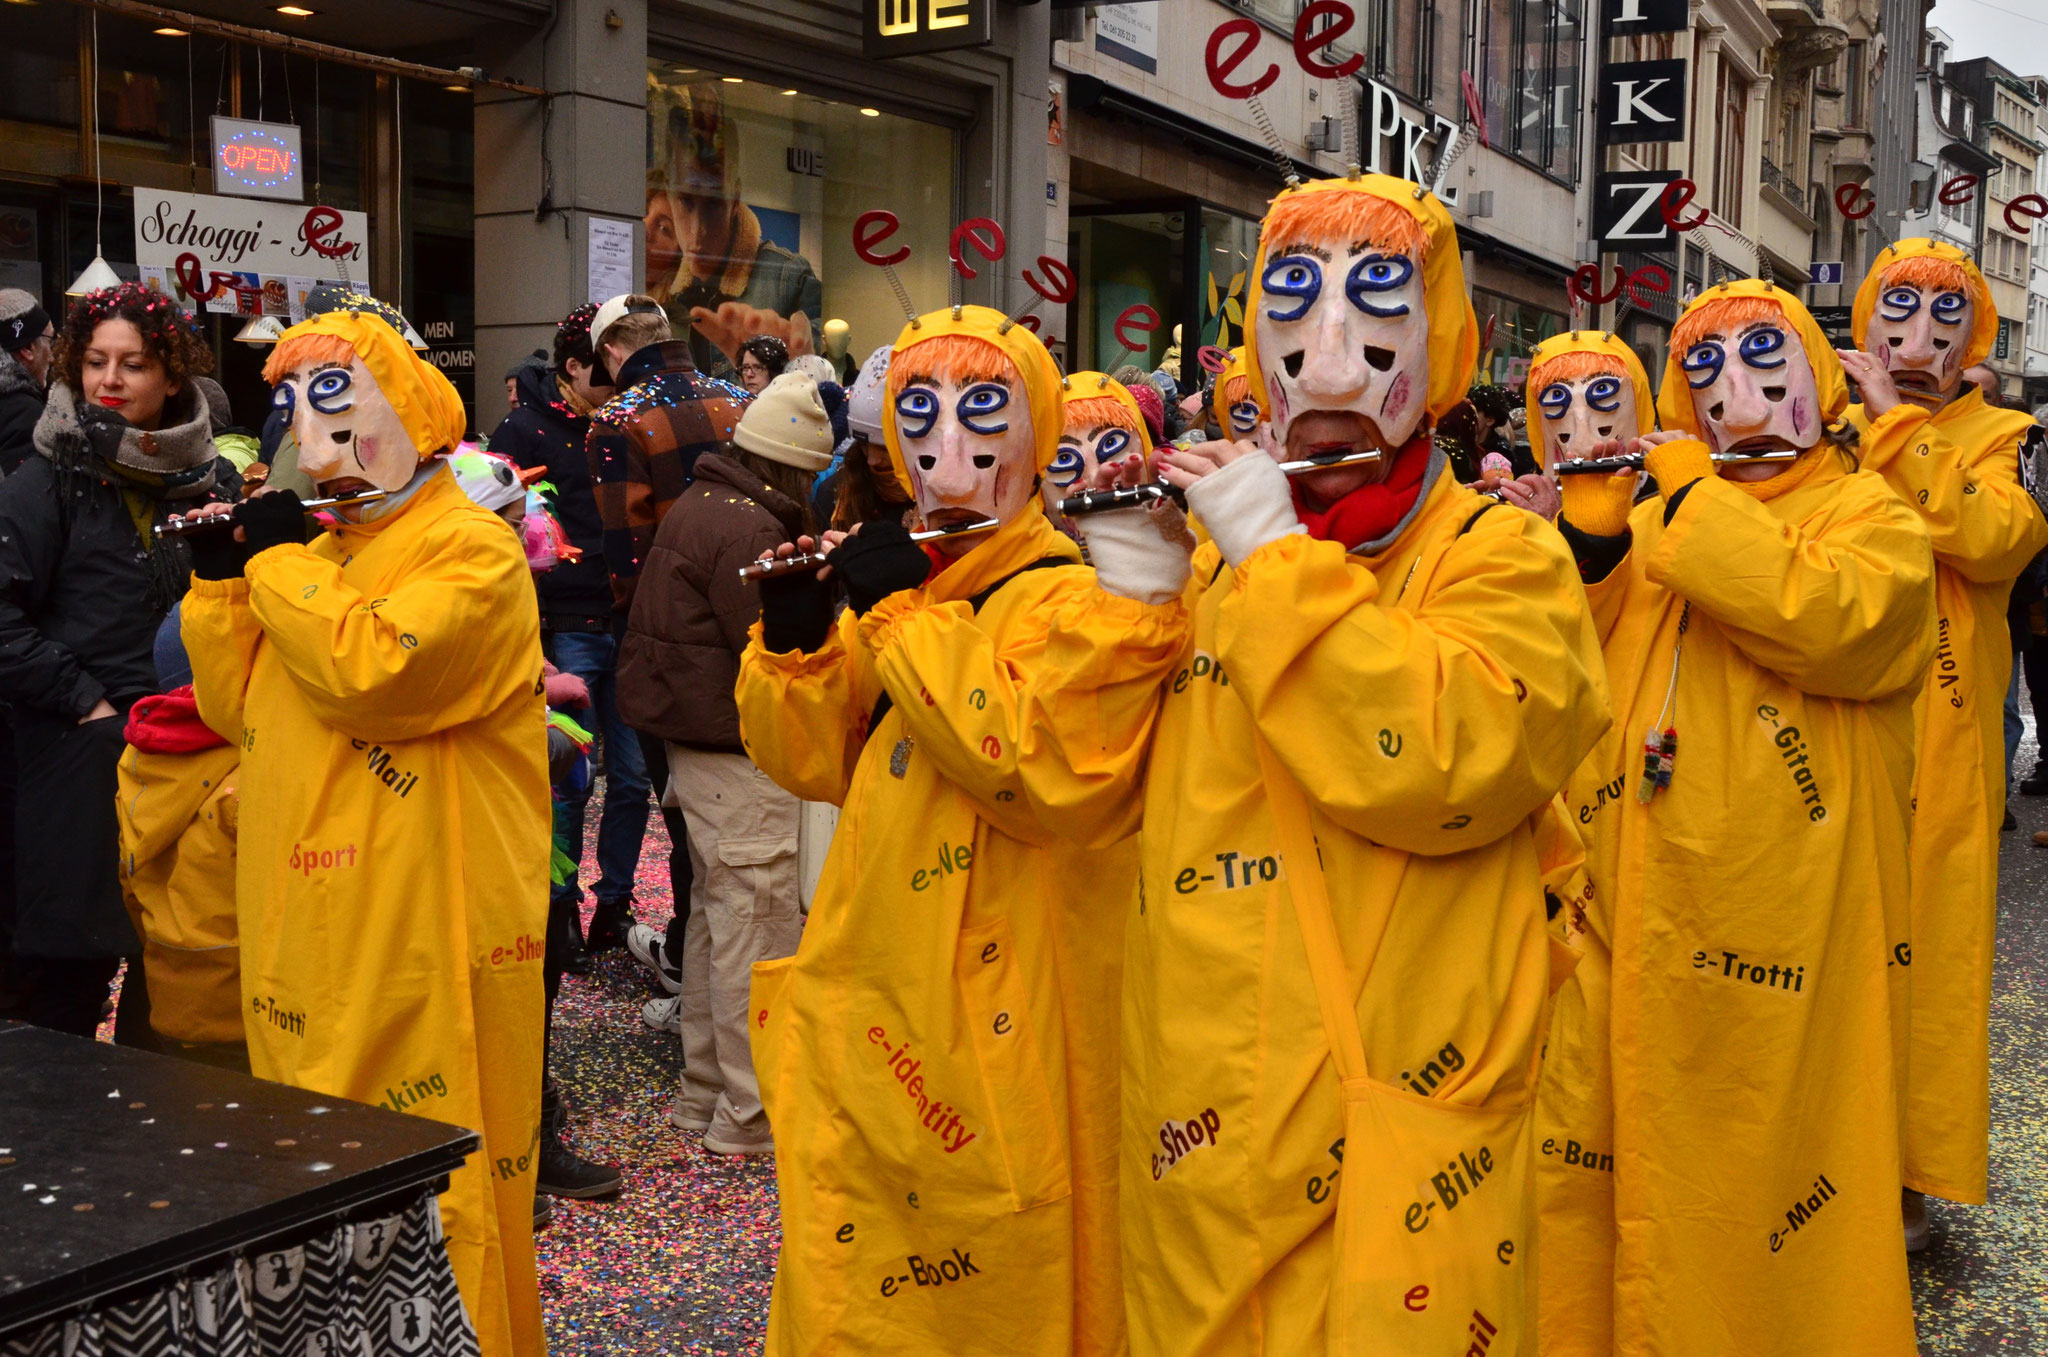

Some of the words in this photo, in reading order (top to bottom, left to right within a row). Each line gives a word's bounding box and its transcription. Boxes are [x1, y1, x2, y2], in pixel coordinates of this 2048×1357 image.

[222, 145, 291, 174] OPEN
[1365, 78, 1460, 207] PKZ
[141, 200, 262, 263] Schoggi
[424, 321, 454, 339] MEN
[1998, 323, 2007, 357] DEPOT
[1757, 704, 1827, 822] e-Gitarre
[911, 841, 976, 893] e-Ne
[1174, 851, 1283, 895] e-Tro
[1692, 950, 1804, 993] e-Trotti
[253, 995, 306, 1039] e-Trotti
[867, 1025, 977, 1154] e-identity
[1151, 1106, 1222, 1181] e-Shop
[1404, 1145, 1495, 1234] e-Bike
[1769, 1174, 1838, 1254] e-Mail
[880, 1247, 981, 1298] e-Book
